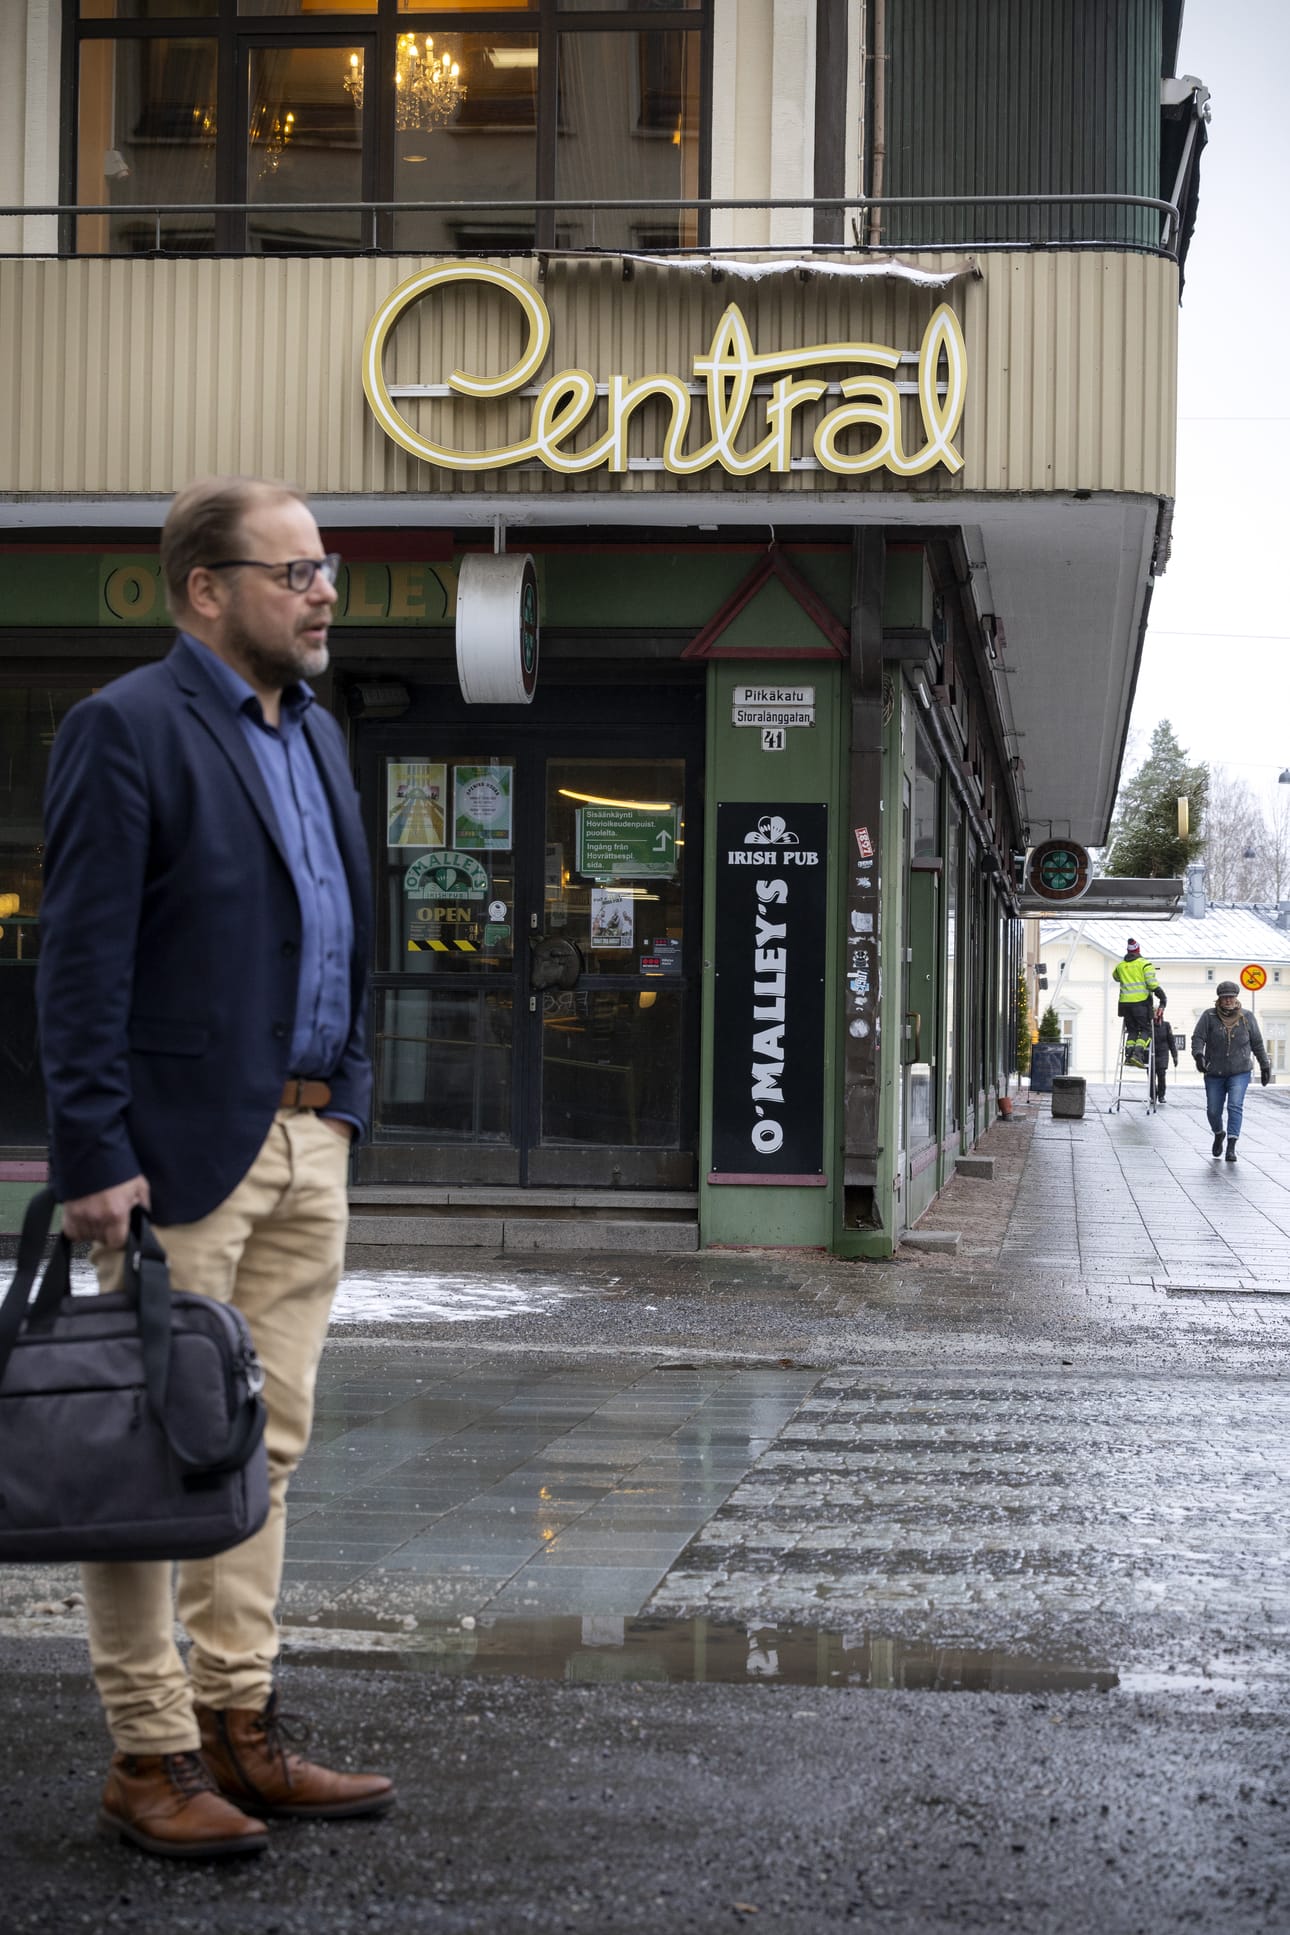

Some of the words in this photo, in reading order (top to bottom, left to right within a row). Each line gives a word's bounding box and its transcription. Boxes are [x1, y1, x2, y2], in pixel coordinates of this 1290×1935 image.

[362, 260, 967, 476] Central
[744, 689, 804, 702] Pitkäkatu
[737, 710, 810, 725] Storalånggatan
[763, 731, 783, 748] 41
[587, 843, 613, 851] Ingång
[728, 851, 777, 865] IRISH
[783, 851, 819, 865] PUB
[417, 907, 471, 922] OPEN
[752, 879, 789, 1154] O'MALLEY'S
